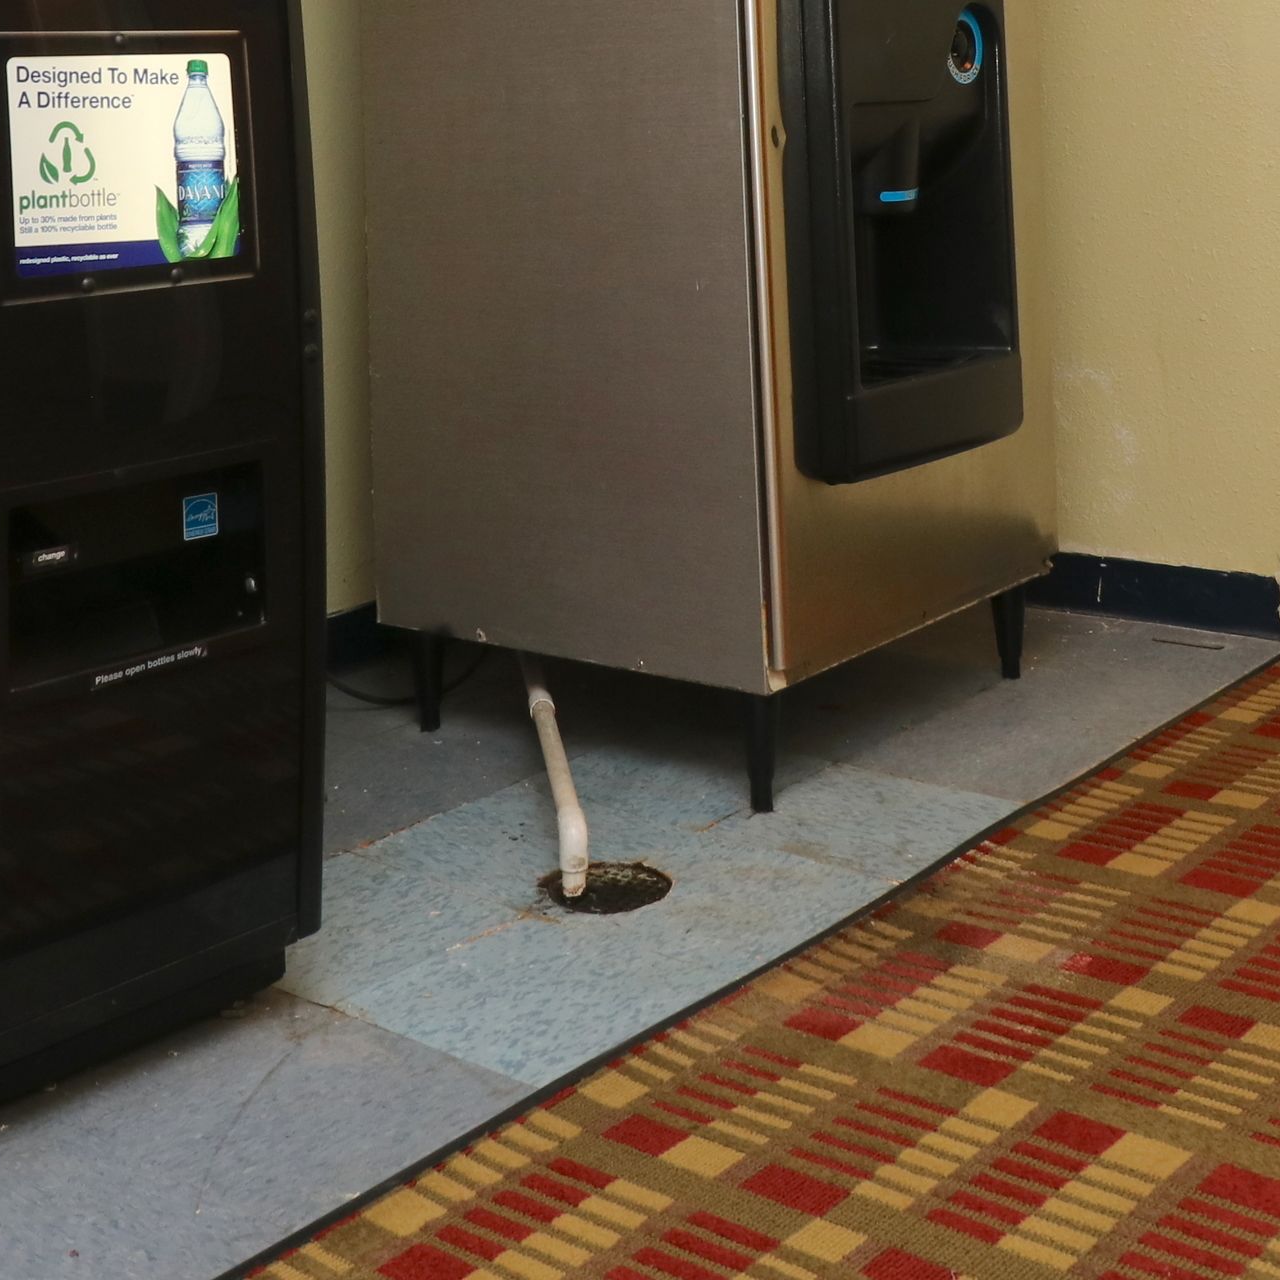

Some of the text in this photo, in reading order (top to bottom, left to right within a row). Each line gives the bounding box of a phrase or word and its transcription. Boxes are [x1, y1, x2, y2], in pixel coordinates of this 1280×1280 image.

[16, 65, 179, 88] Designed To Make
[17, 91, 132, 109] A Difference
[19, 187, 117, 215] plantbottle
[178, 183, 224, 201] DASANI
[19, 216, 30, 225] Up
[40, 215, 55, 223] 30%
[57, 214, 77, 222] made
[78, 214, 95, 222] from
[95, 213, 117, 222] plants
[19, 225, 33, 234] Still
[40, 225, 58, 233] 100%
[59, 223, 95, 232] recyclable
[96, 222, 118, 230] bottle
[37, 550, 66, 562] change
[95, 646, 202, 685] Please open bottles slowly
